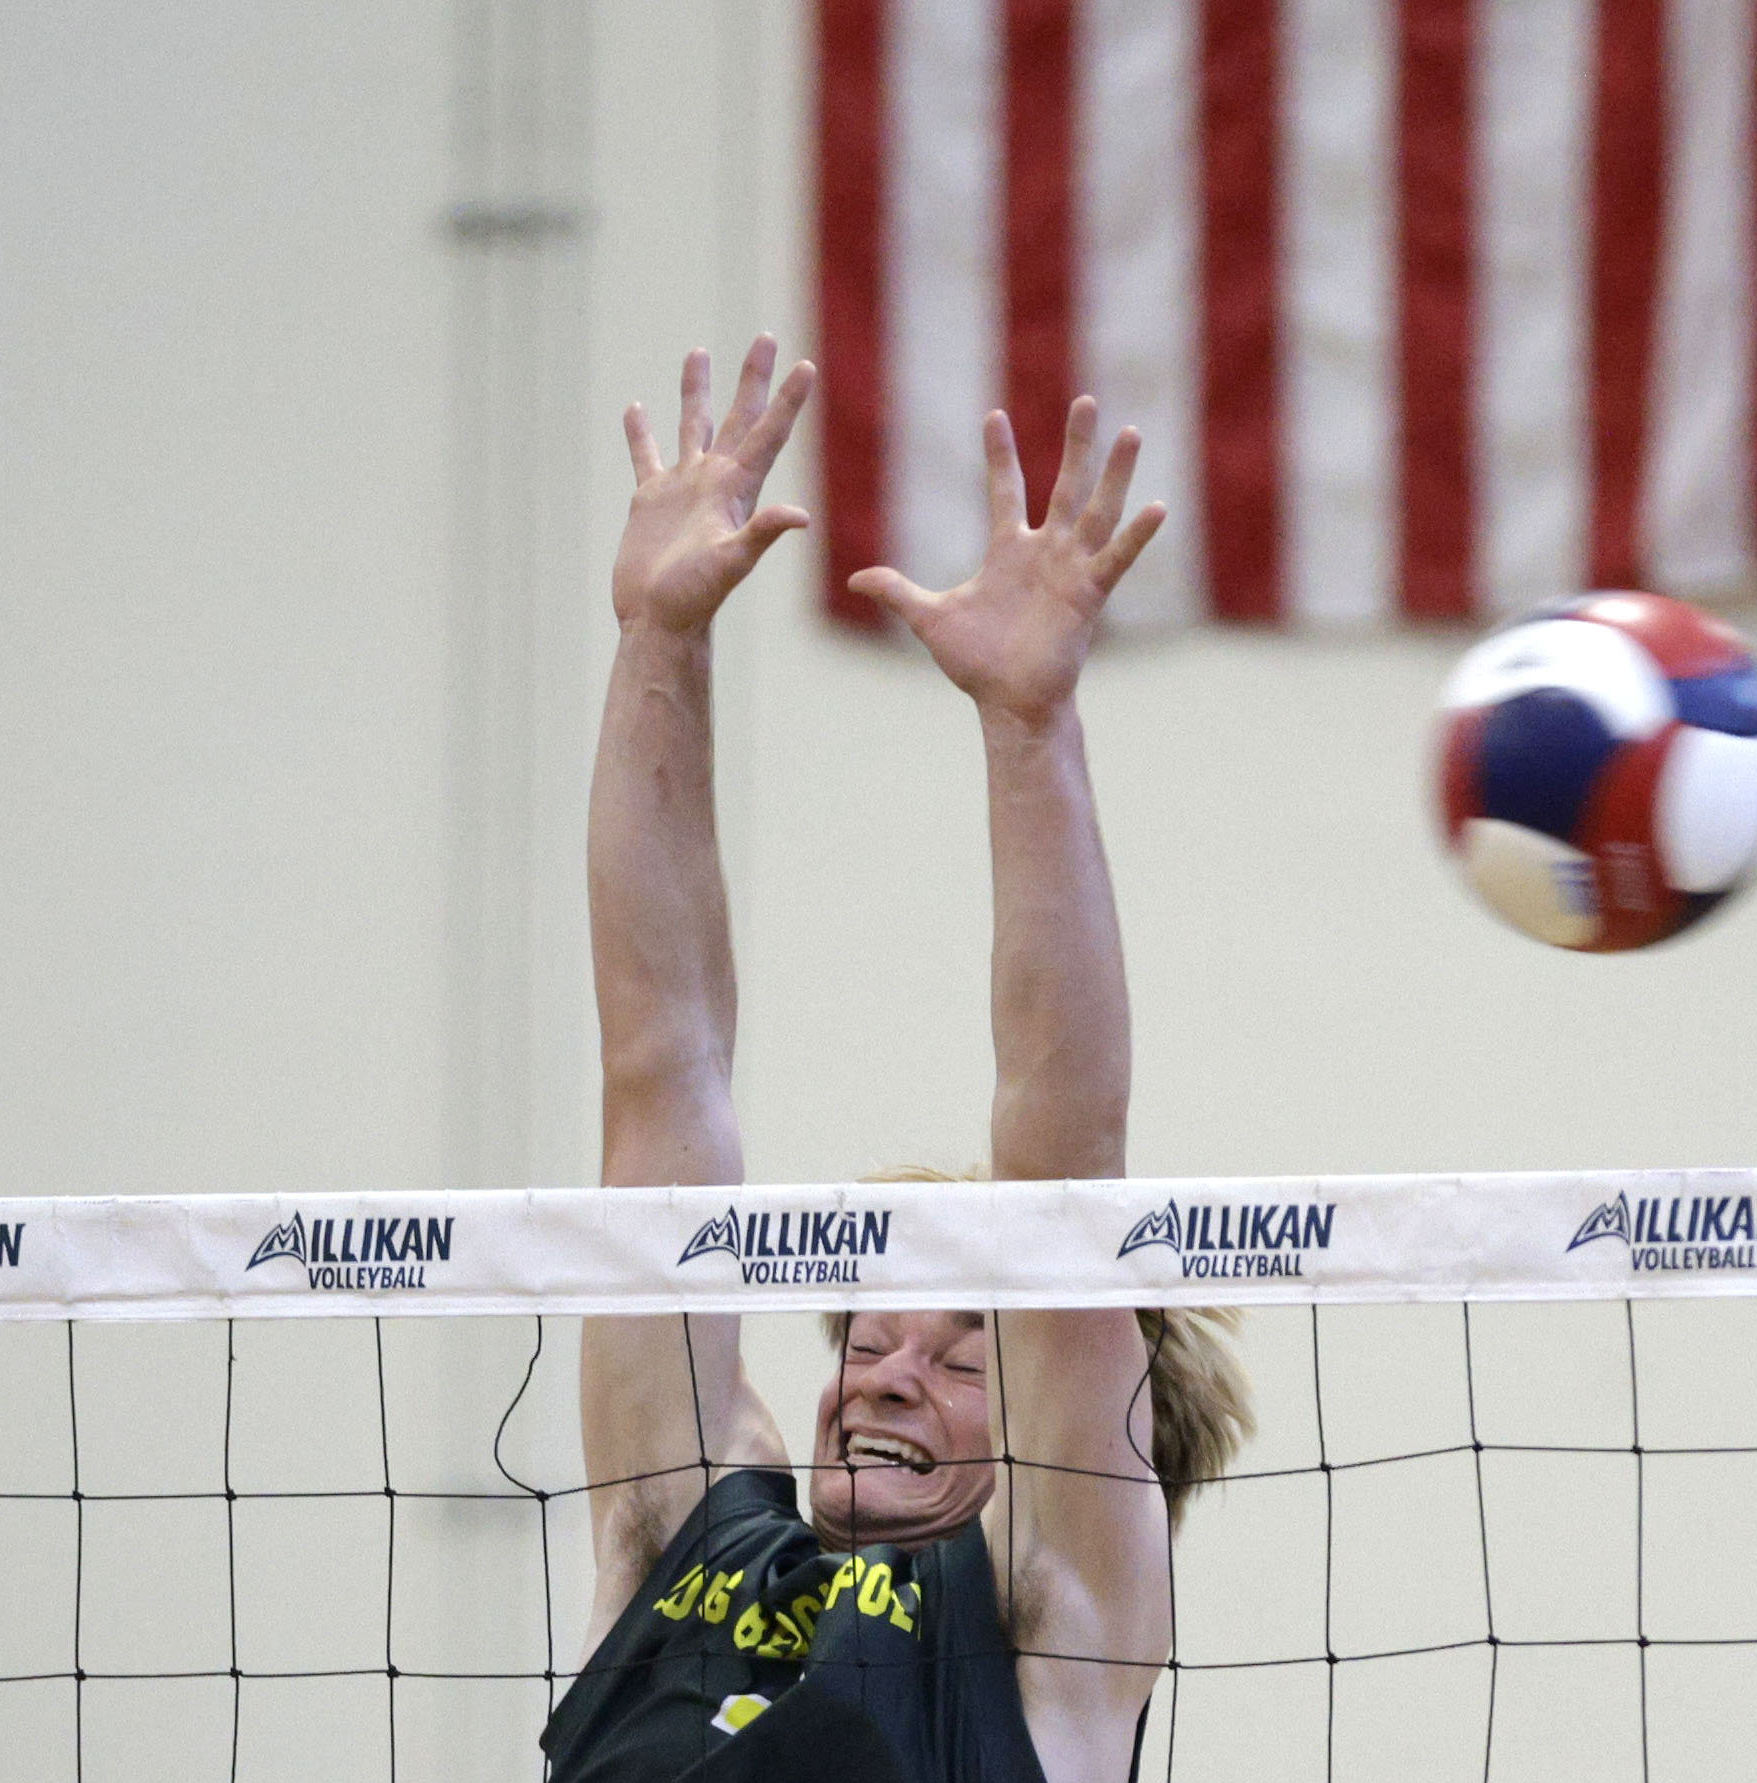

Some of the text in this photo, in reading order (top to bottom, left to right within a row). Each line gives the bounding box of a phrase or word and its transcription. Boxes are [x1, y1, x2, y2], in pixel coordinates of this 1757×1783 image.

[1181, 1254, 1303, 1278] VOLLEYBALL
[1631, 1247, 1756, 1272] VOLLEYBALL
[308, 1265, 426, 1289] VOLLEYBALL
[742, 1260, 860, 1284] VOLLEYBALL
